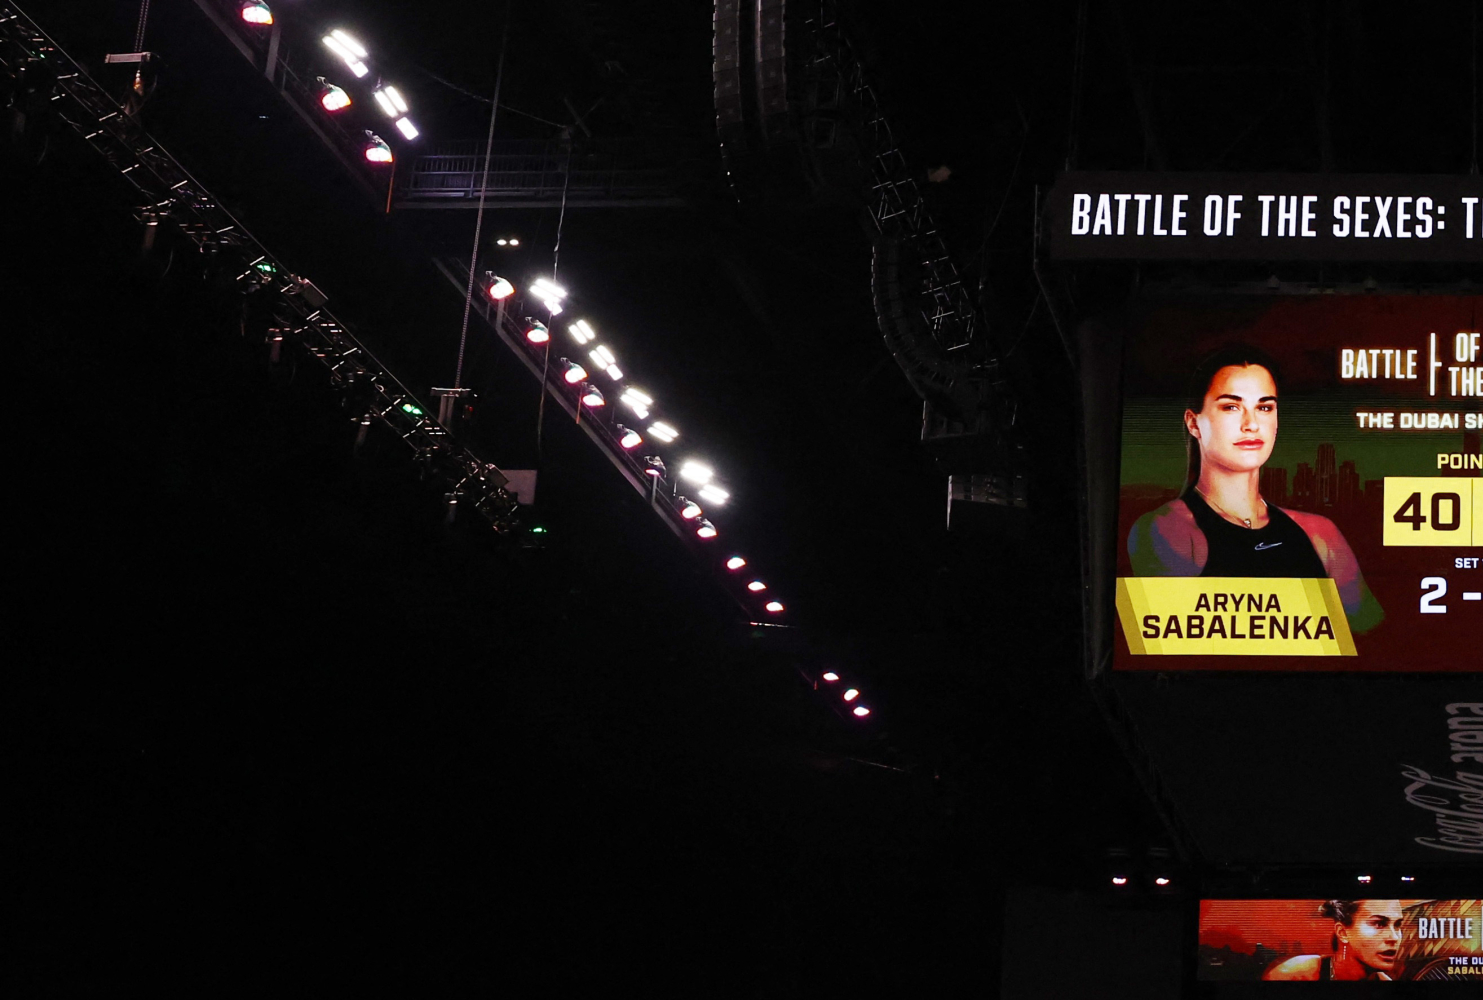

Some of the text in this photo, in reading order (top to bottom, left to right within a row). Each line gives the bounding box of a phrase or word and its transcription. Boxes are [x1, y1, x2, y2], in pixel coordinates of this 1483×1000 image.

[1071, 193, 1189, 236] BATTLE
[1203, 194, 1243, 237] OF
[1257, 195, 1318, 237] THE
[1332, 195, 1445, 238] SEXES:
[1341, 348, 1418, 379] BATTLE
[1455, 332, 1481, 363] OF
[1356, 412, 1395, 429] THE
[1399, 412, 1459, 429] DUBAI
[1392, 491, 1461, 532] 40
[1455, 557, 1479, 569] SET
[1194, 594, 1282, 613] ARYNA
[1420, 576, 1447, 614] 2
[1142, 614, 1335, 640] SABALENKA
[1419, 918, 1473, 939] BATTLE
[1449, 956, 1469, 965] THE
